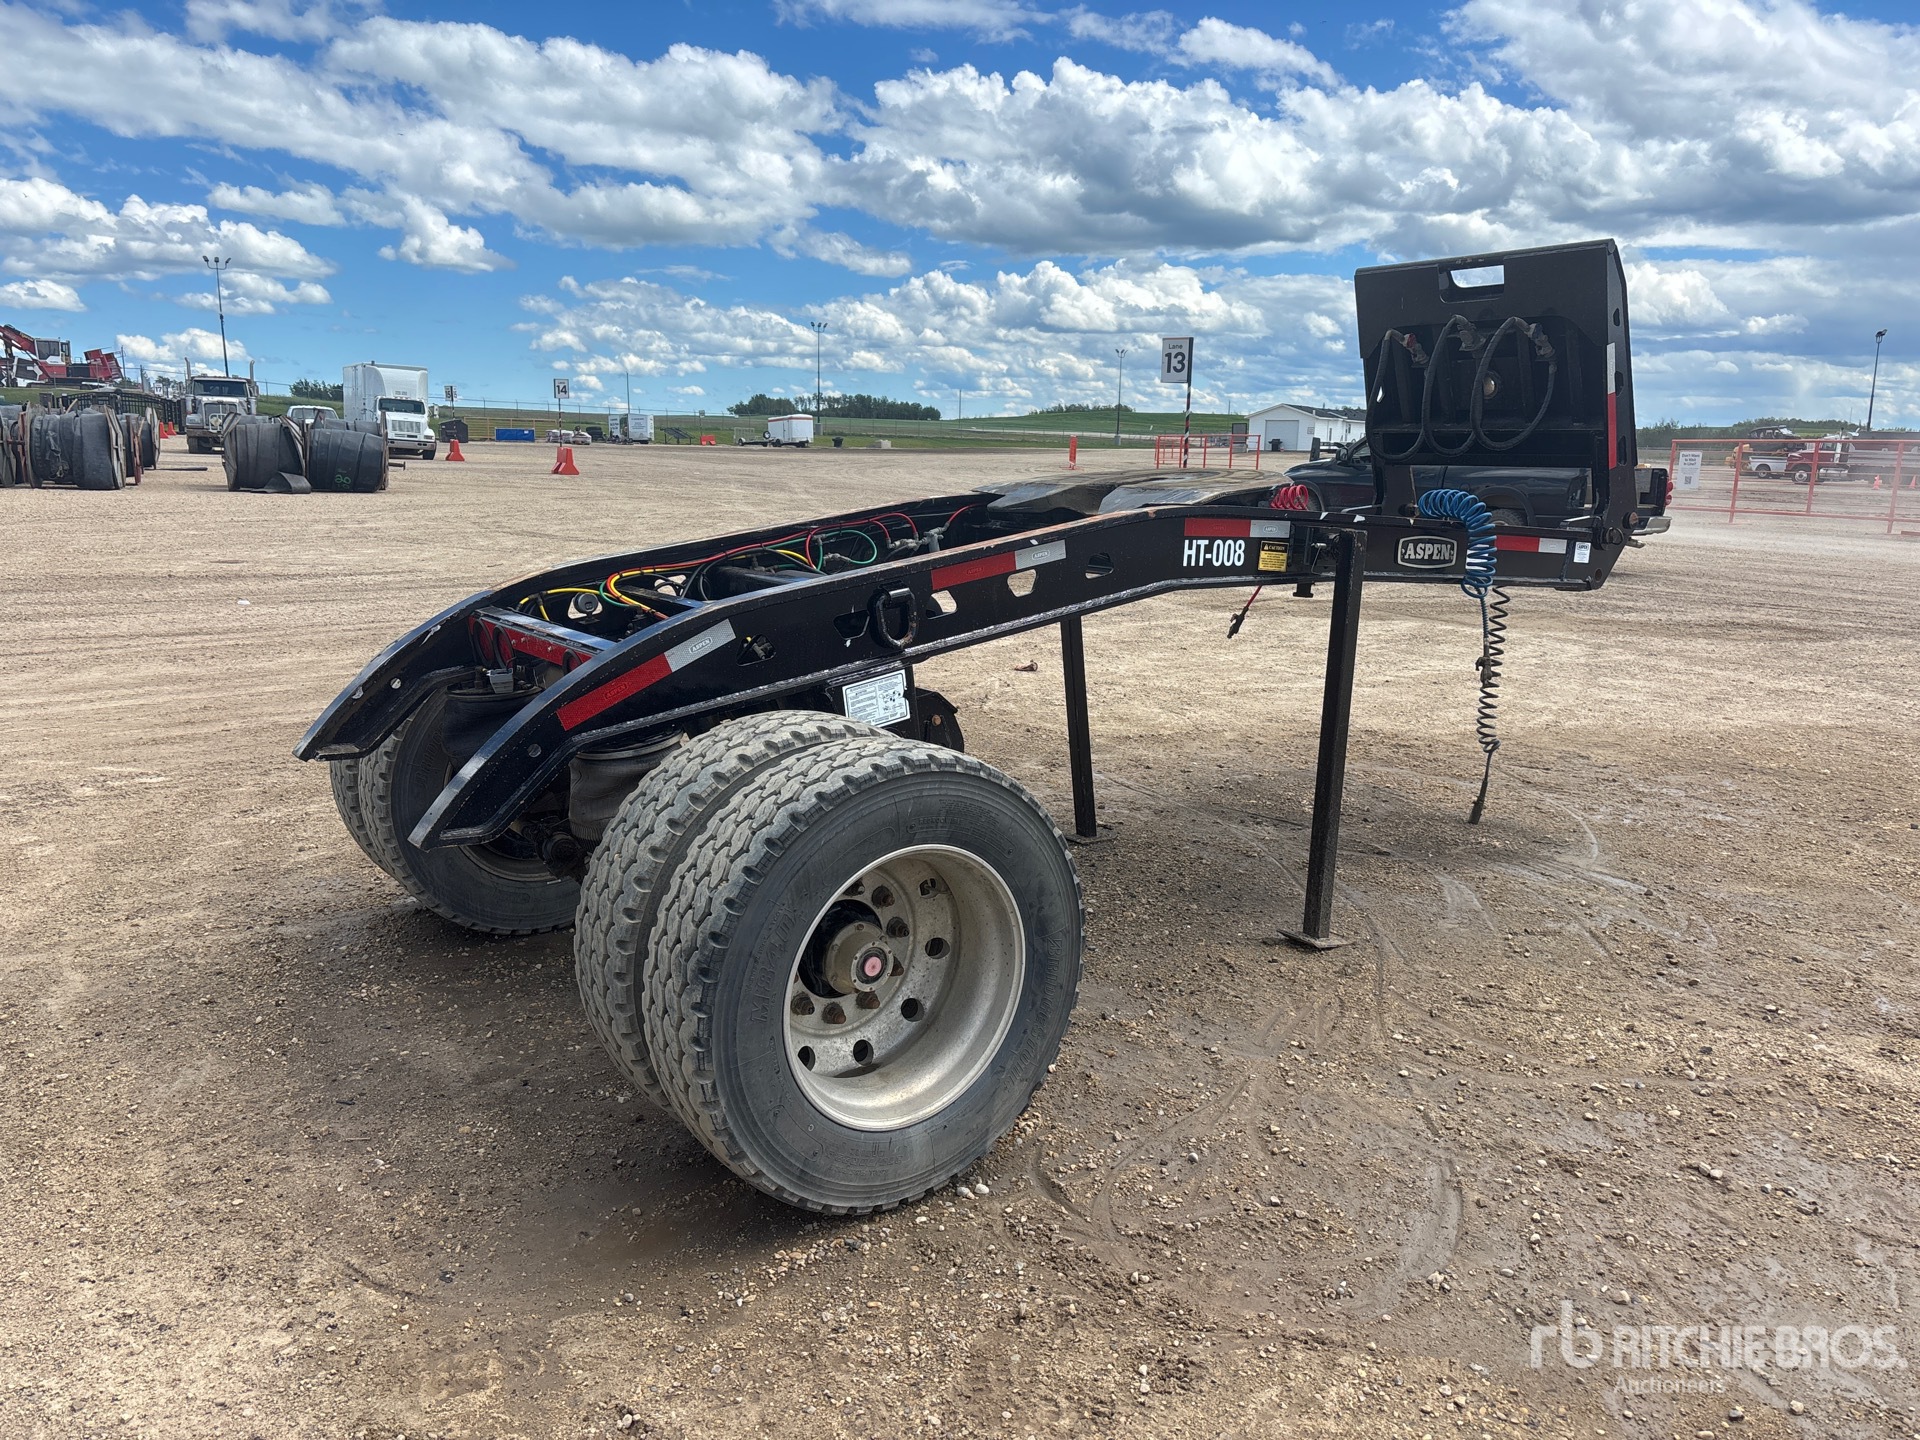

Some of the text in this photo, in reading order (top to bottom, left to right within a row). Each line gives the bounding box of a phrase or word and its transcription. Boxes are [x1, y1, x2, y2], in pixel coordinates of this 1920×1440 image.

[1164, 351, 1186, 374] 13
[556, 385, 567, 395] 14
[1033, 551, 1049, 559] ASPEN
[1182, 539, 1246, 567] HT-008
[1404, 542, 1451, 560] ASPEN
[691, 637, 711, 653] ASPEN
[605, 683, 627, 699] ASPEN
